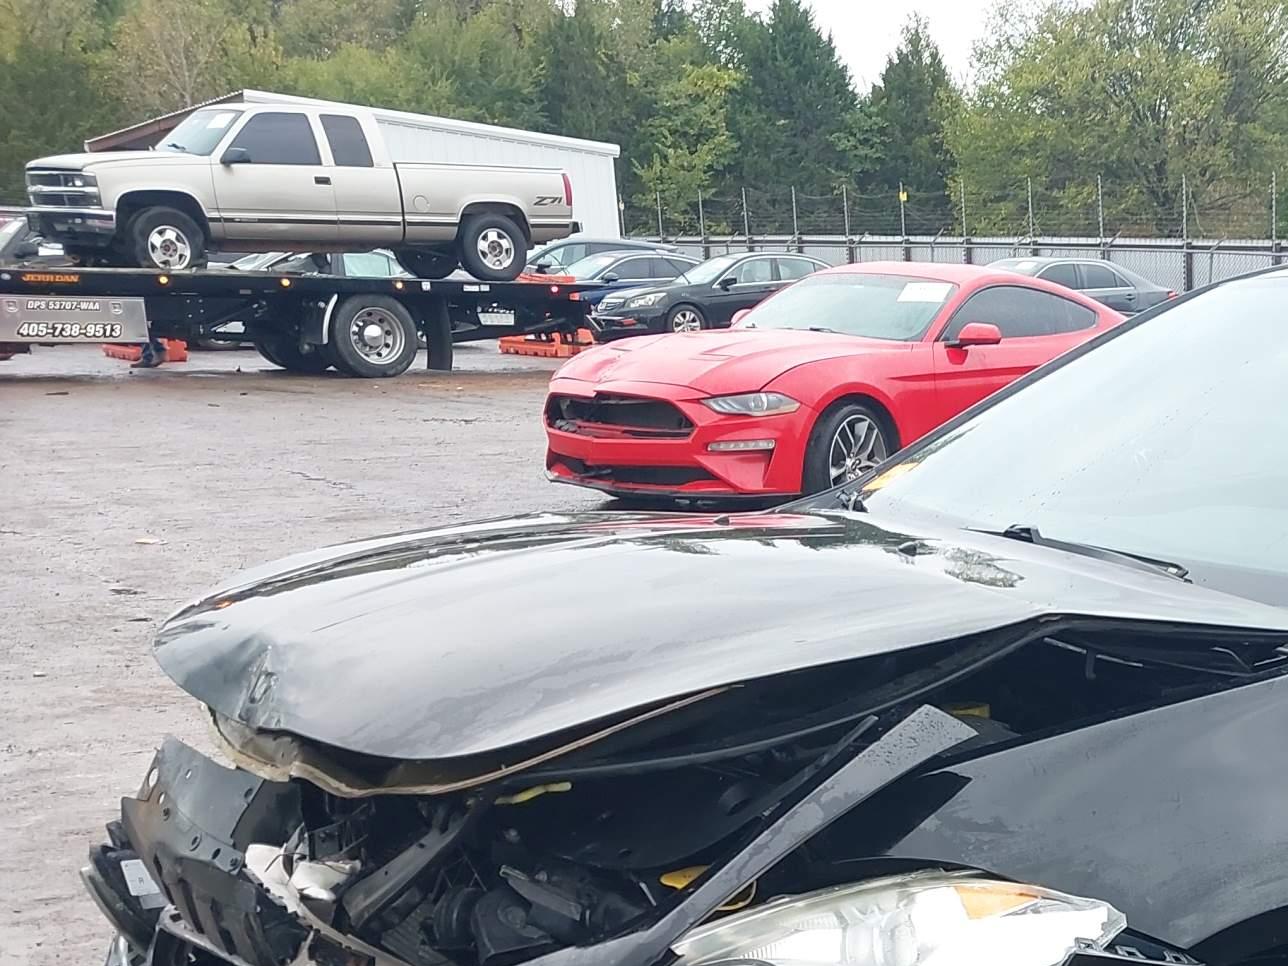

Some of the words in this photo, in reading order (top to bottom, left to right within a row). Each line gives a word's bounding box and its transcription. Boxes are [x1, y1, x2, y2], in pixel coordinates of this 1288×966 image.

[533, 196, 563, 206] Z71
[26, 300, 46, 309] DPS
[48, 301, 100, 310] 53707-WAA
[18, 323, 122, 337] 405-738-9513
